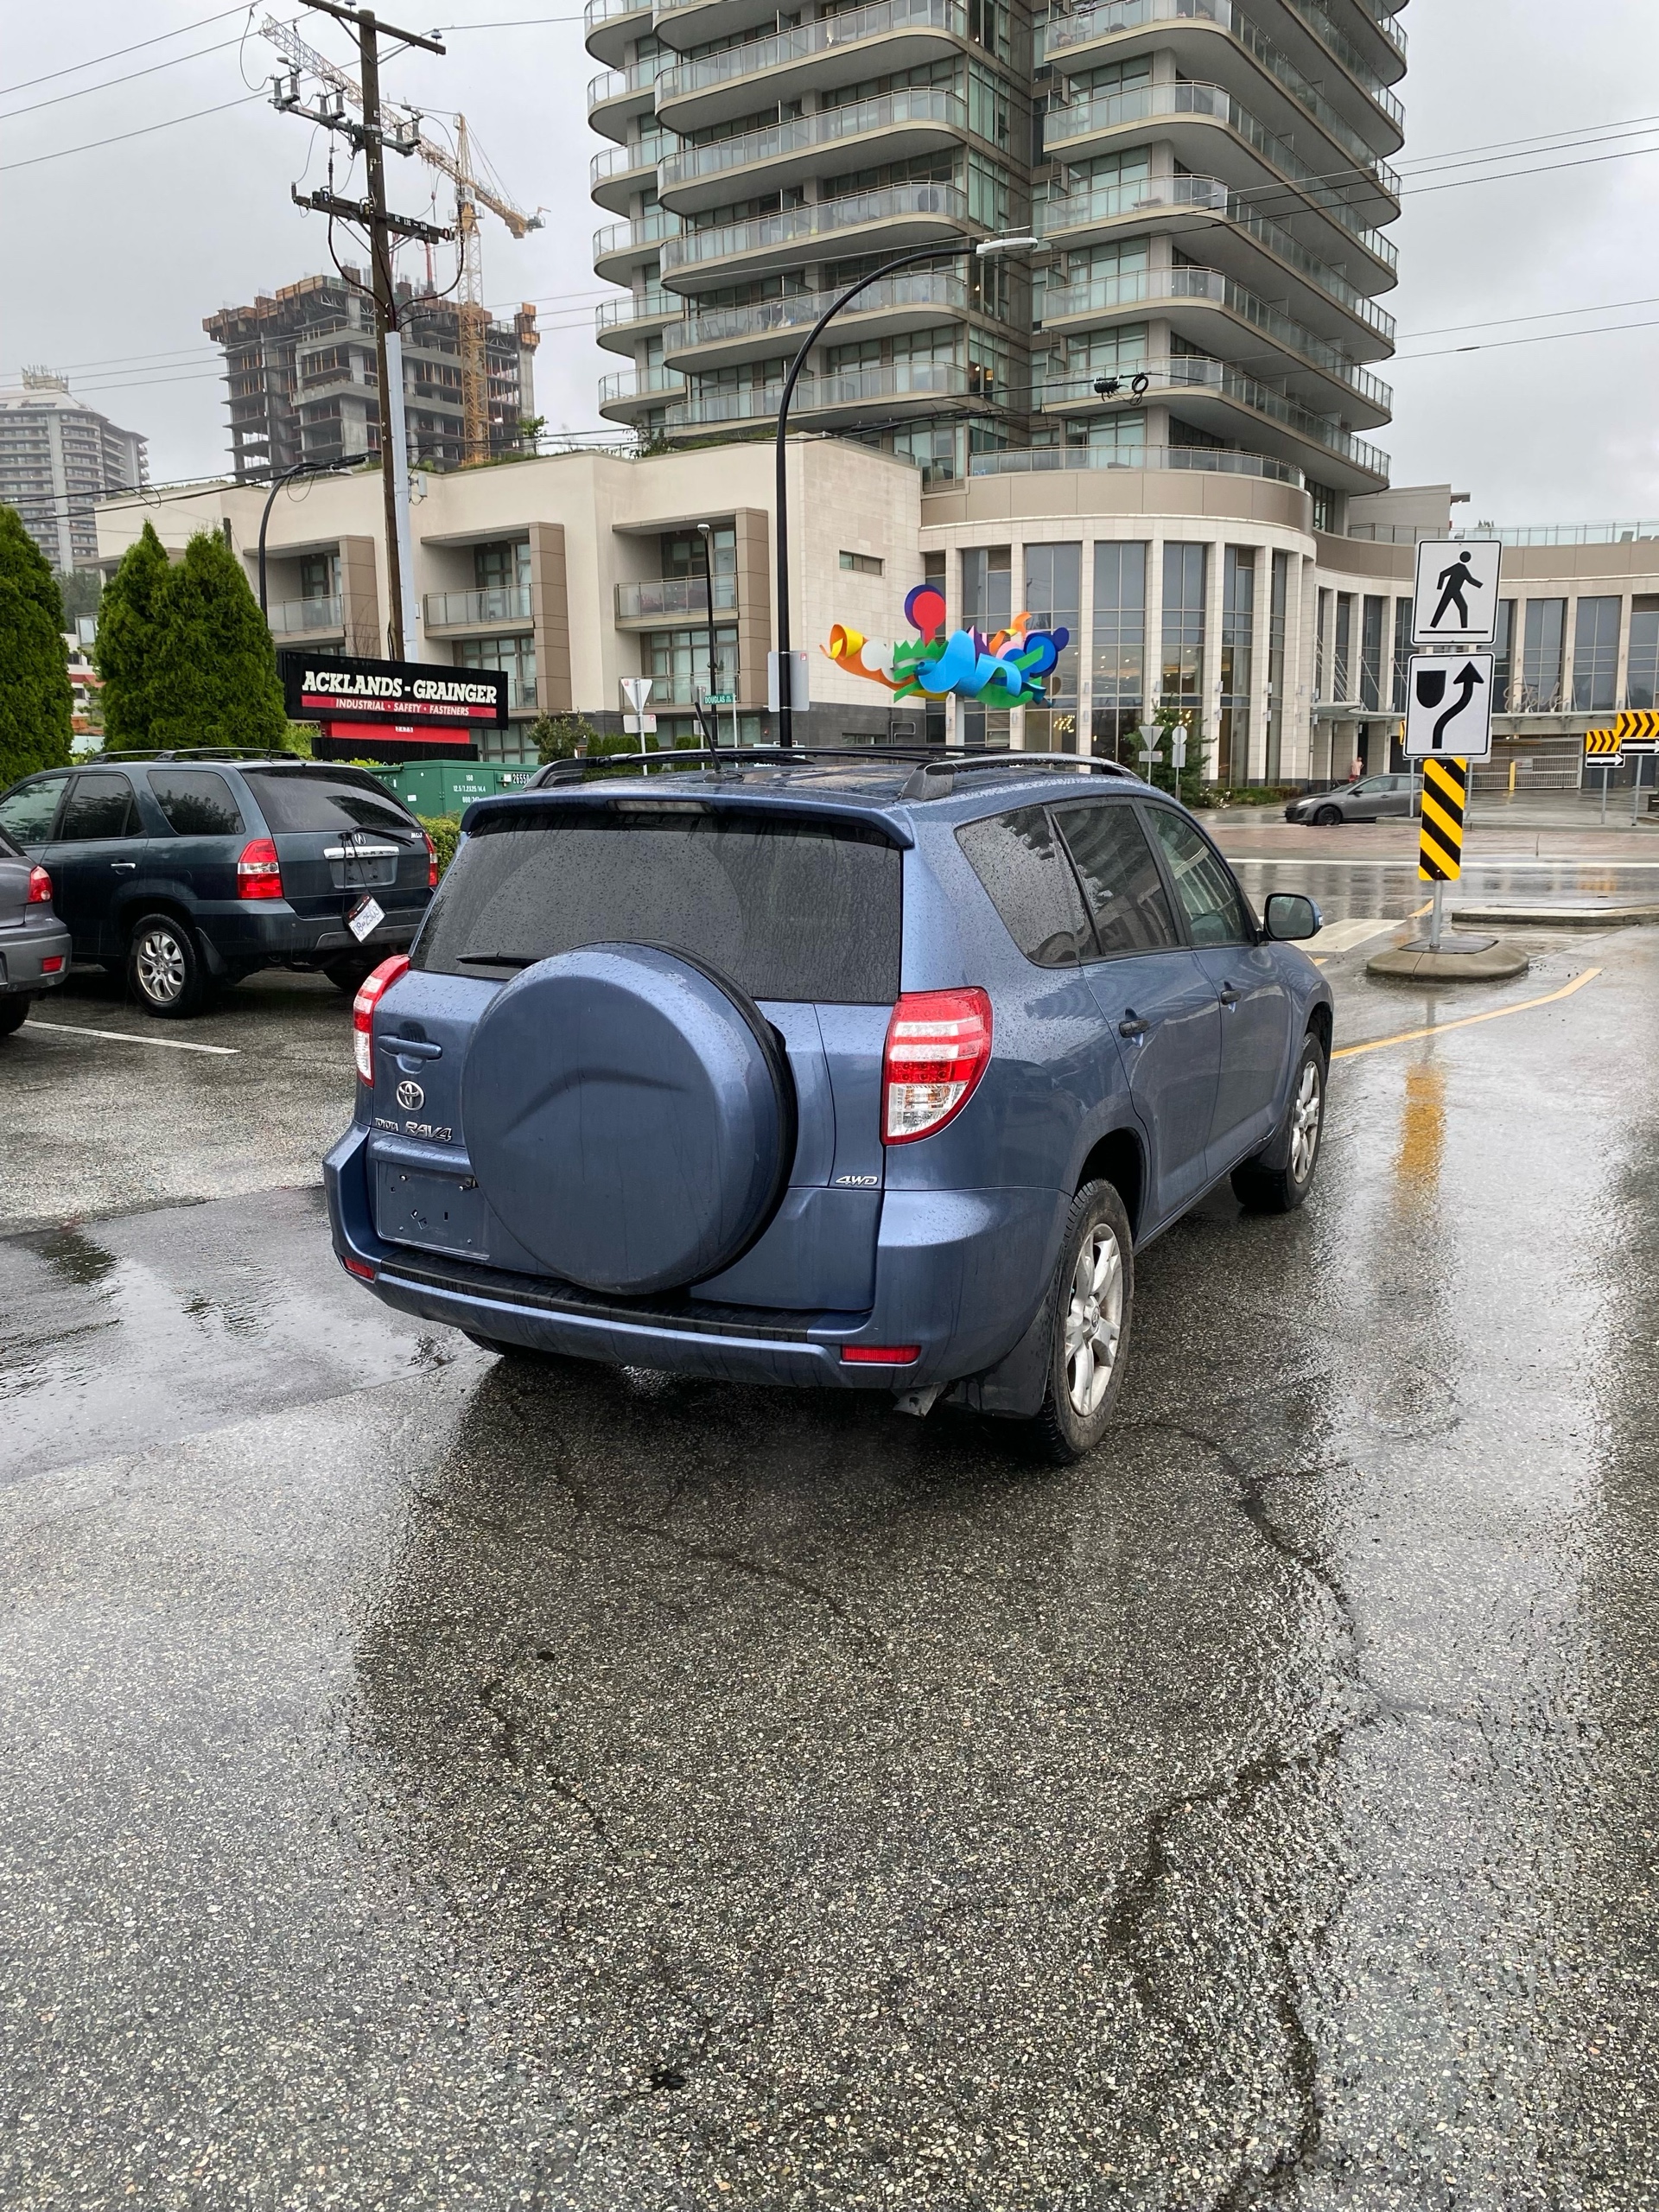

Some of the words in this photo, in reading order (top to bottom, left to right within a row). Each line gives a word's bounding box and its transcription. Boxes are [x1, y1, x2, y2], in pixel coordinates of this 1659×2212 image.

[704, 695, 726, 704] DOUGLAS
[335, 698, 385, 712] INDUSTRIAL
[393, 702, 422, 714] SAFETY
[429, 705, 470, 716] FASTENERS
[374, 1117, 399, 1131] TOYOTA
[405, 1121, 452, 1141] RAV4
[835, 1175, 879, 1185] 4WD
